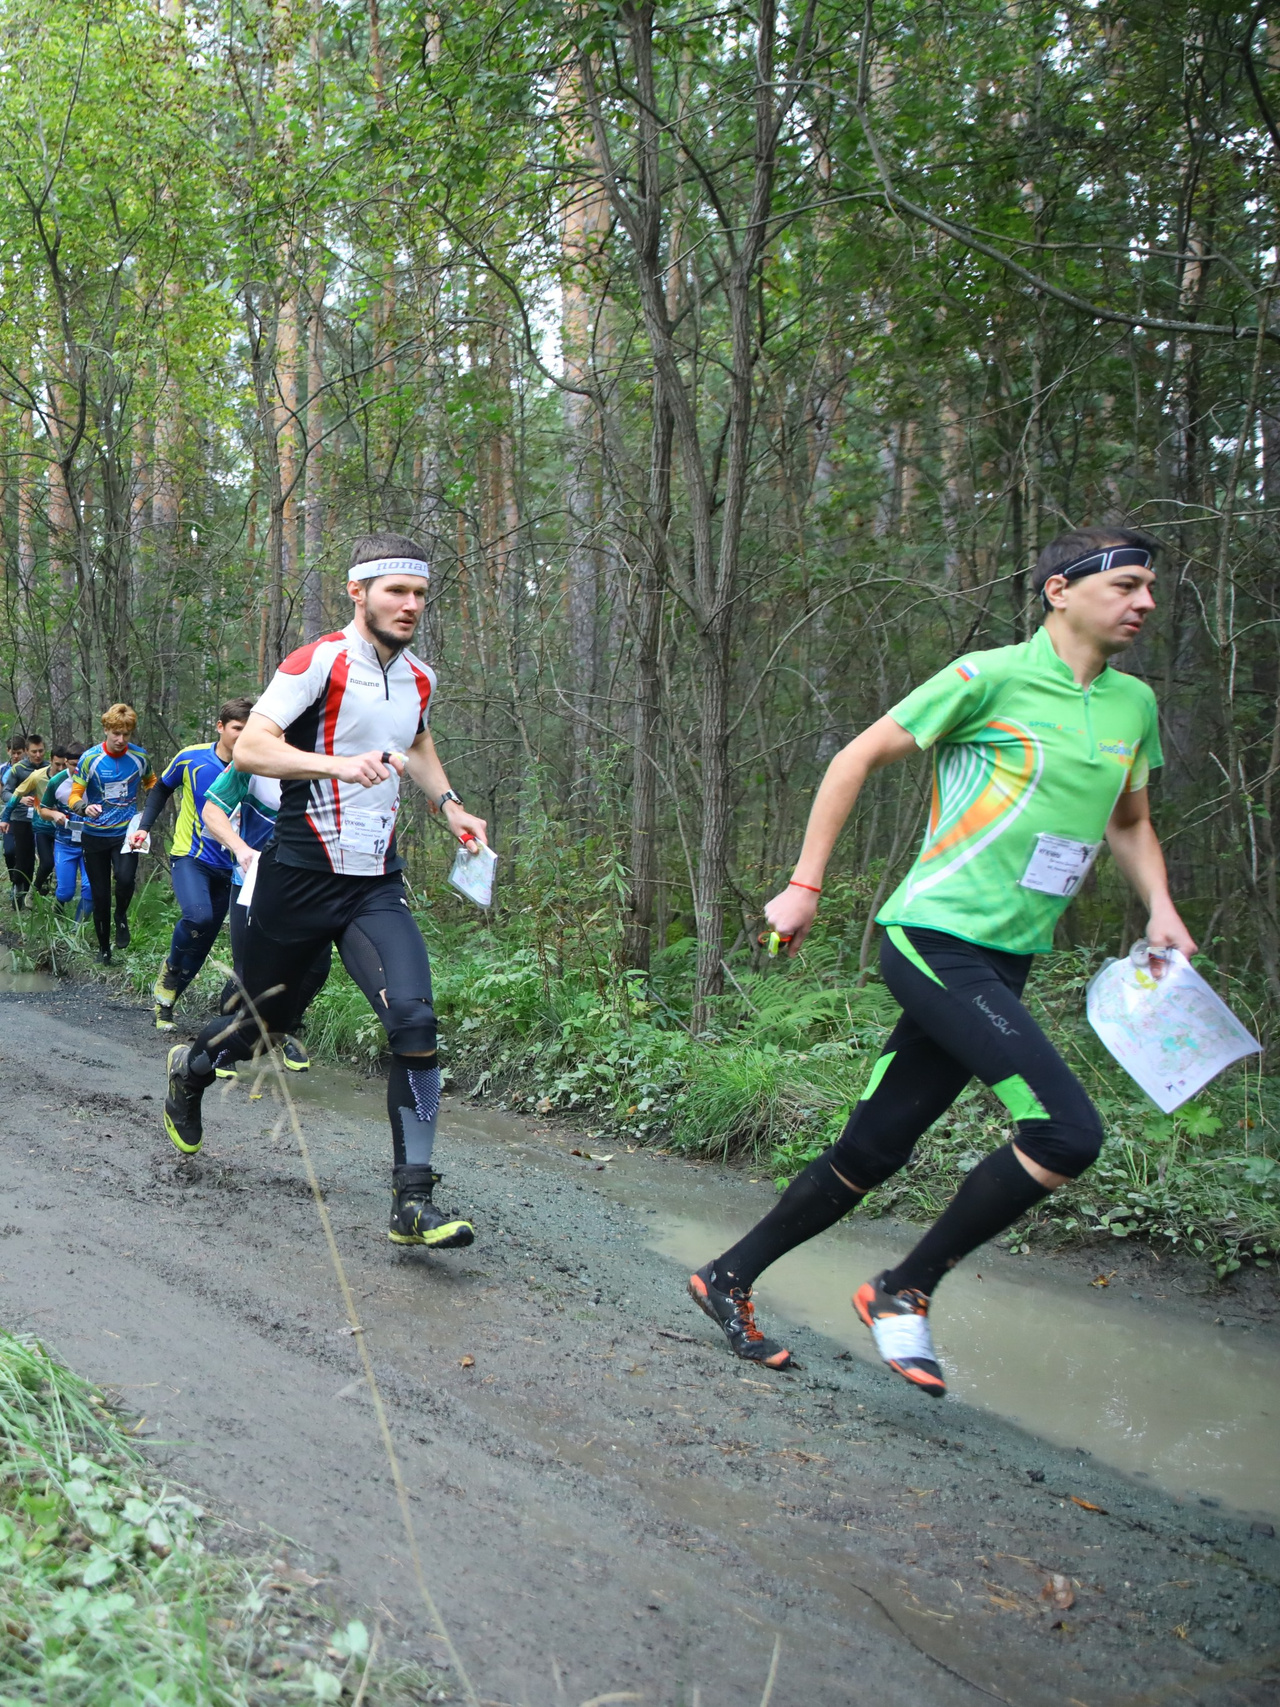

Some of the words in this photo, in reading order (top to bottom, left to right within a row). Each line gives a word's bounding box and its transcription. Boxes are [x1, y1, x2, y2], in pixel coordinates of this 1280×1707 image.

[350, 678, 380, 688] noname
[373, 839, 386, 855] 12
[1062, 875, 1081, 894] 17
